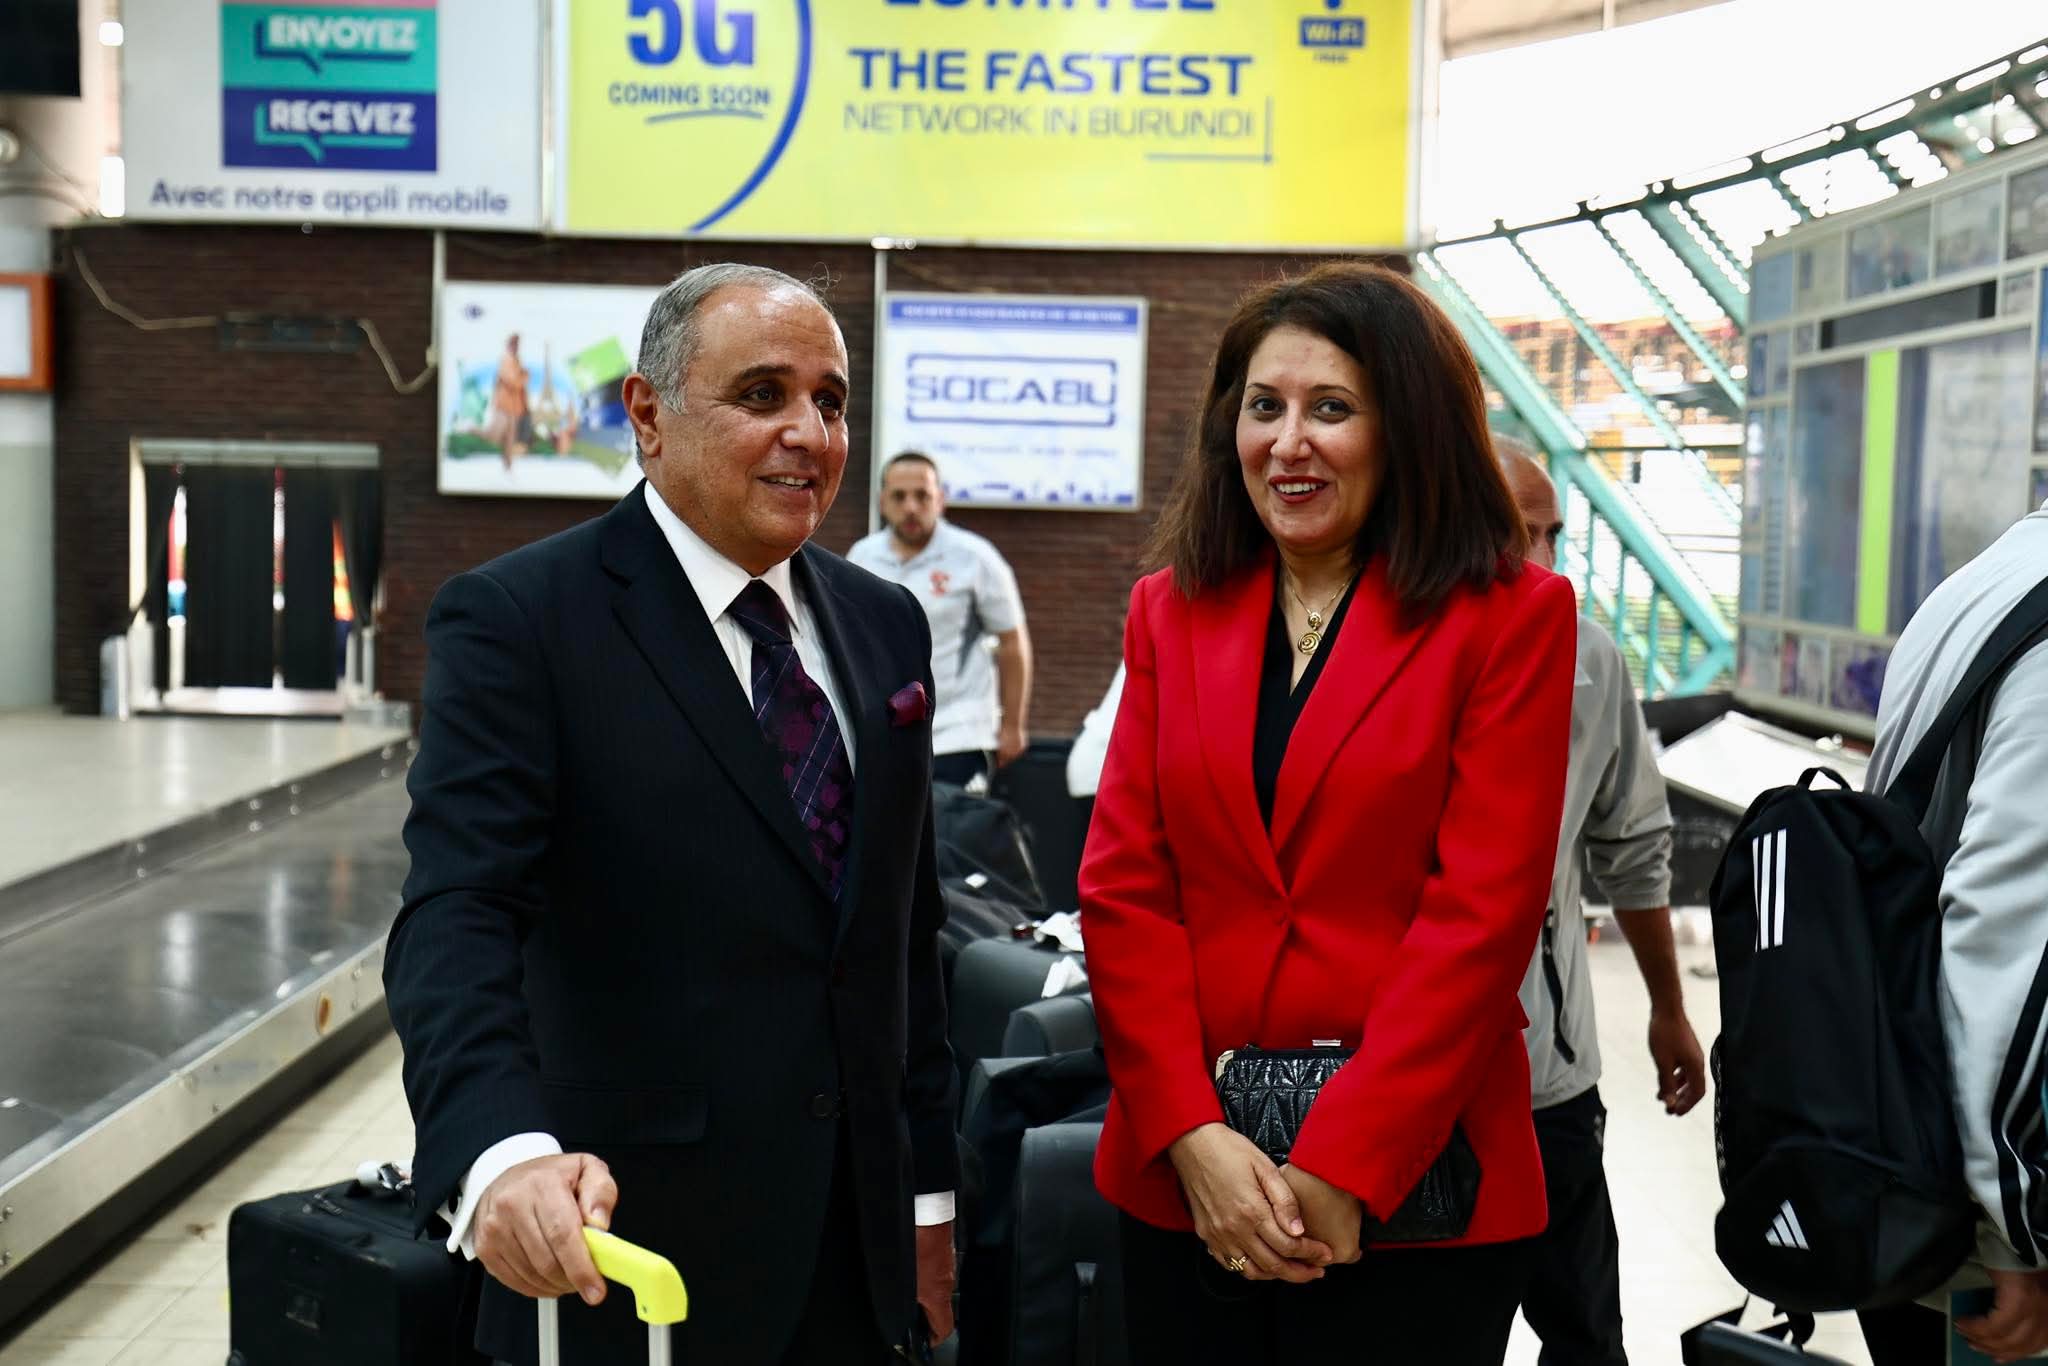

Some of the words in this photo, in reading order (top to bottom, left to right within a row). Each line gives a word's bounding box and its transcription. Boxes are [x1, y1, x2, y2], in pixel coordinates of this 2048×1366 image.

[268, 16, 418, 49] ENVOYEZ
[626, 0, 755, 67] 5G
[849, 48, 967, 91] THE
[985, 52, 1253, 96] FASTEST
[608, 83, 699, 104] COMING
[708, 86, 770, 106] SOON
[269, 99, 416, 133] RECEVEZ
[843, 104, 1033, 133] NETWORK
[1043, 107, 1077, 134] IN
[1089, 108, 1252, 137] BURUNDI
[151, 180, 224, 208] Avec
[234, 183, 313, 207] notre
[322, 186, 398, 218] appli
[407, 188, 509, 212] mobile
[907, 374, 1116, 407] SOCABU
